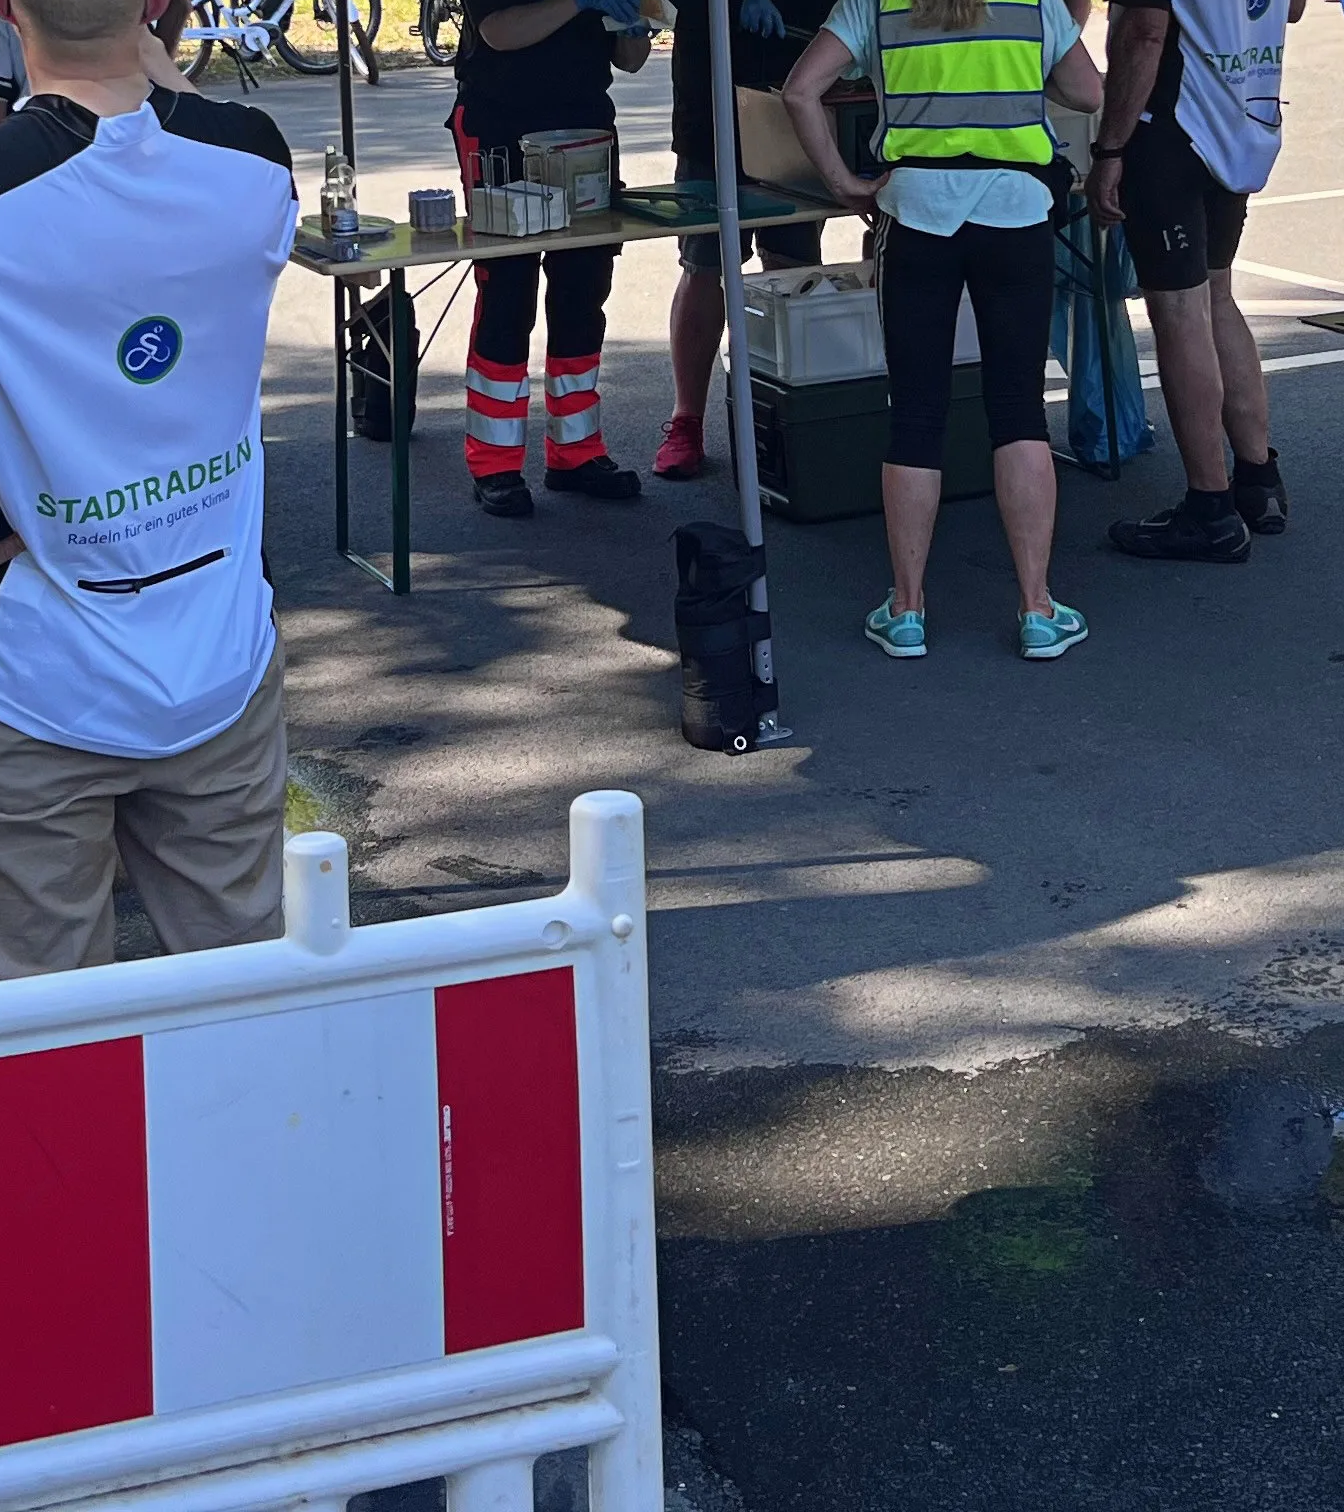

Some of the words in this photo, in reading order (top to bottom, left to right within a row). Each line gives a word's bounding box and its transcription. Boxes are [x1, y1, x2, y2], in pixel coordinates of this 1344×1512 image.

[37, 436, 253, 524] STADTRADELN
[67, 529, 121, 545] Radeln
[125, 520, 141, 539] für
[145, 516, 163, 532] ein
[167, 502, 198, 528] gutes
[202, 489, 230, 510] Klima
